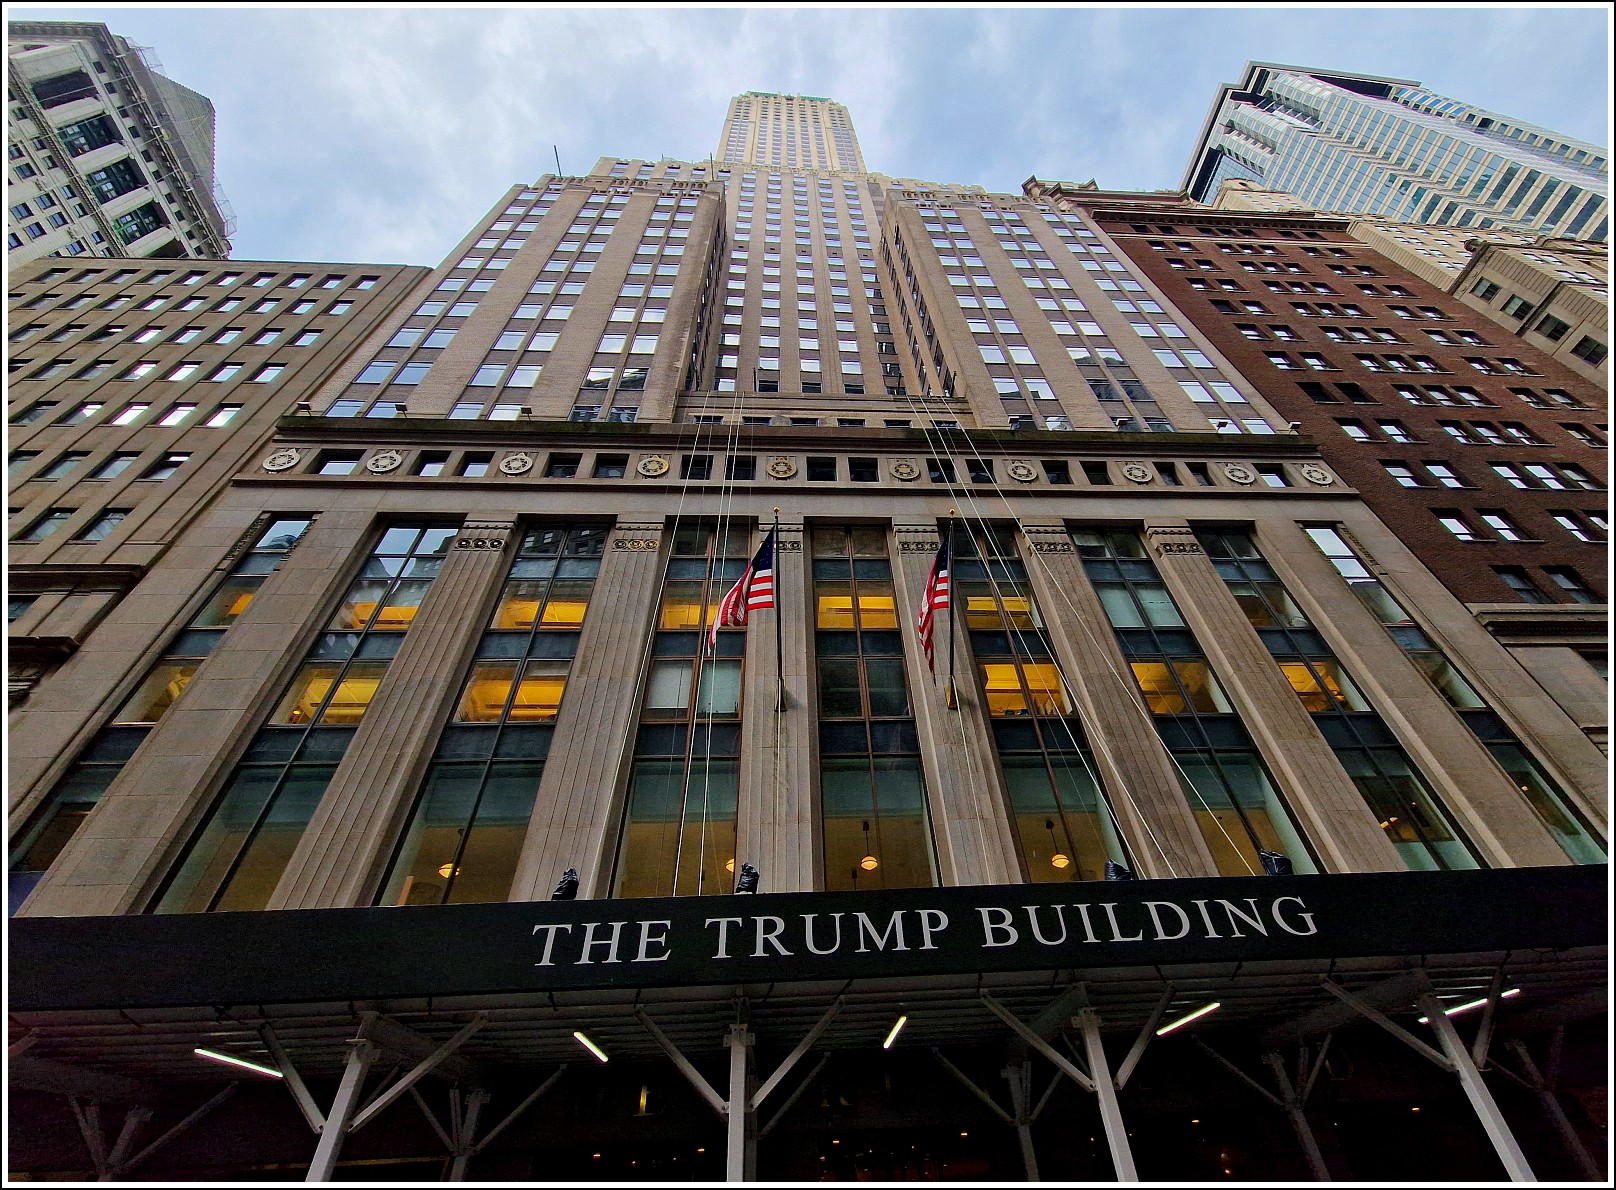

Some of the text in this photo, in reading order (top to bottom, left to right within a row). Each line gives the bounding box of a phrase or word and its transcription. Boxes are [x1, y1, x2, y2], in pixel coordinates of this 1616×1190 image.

[532, 896, 1318, 966] THE TRUMP BUILDING
